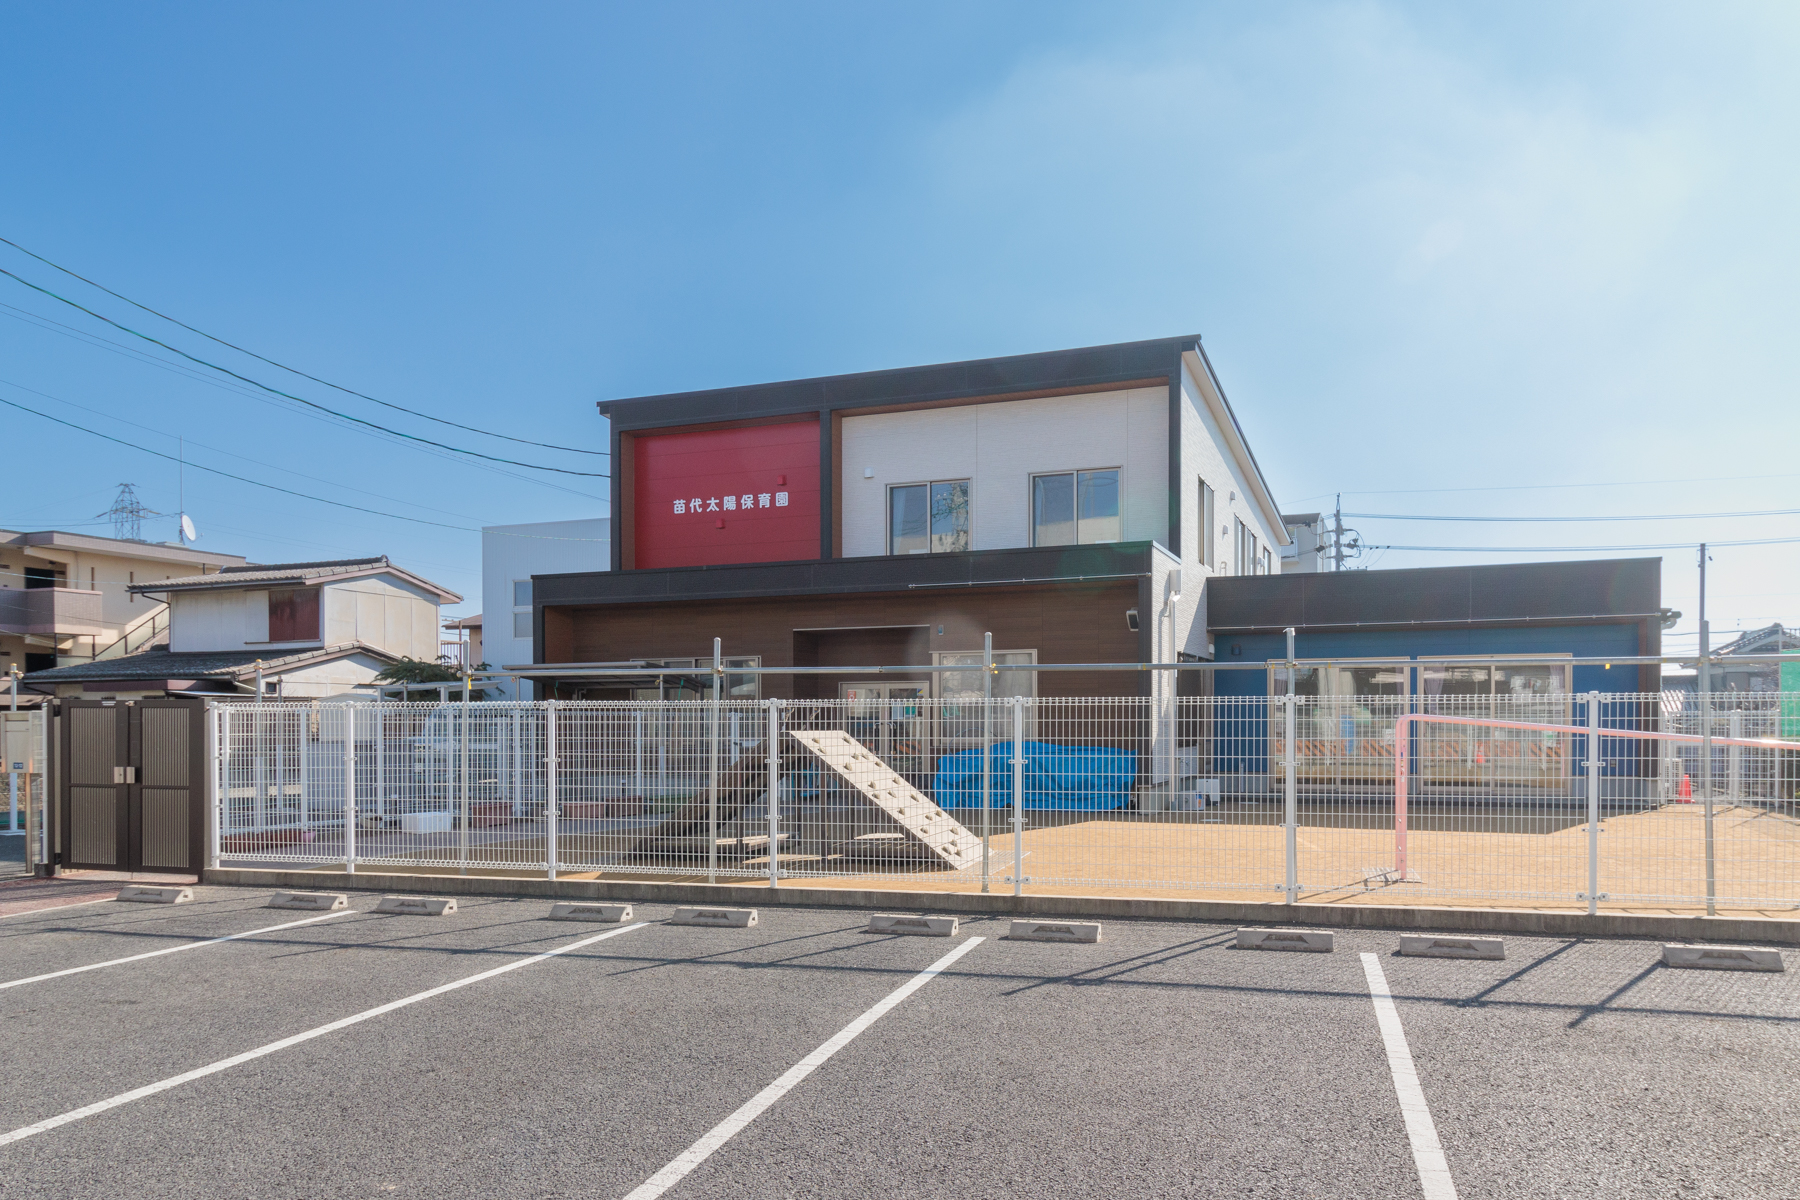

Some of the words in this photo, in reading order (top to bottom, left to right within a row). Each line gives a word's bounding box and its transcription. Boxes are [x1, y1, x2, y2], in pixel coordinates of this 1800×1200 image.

[673, 491, 789, 514] 苗代太陽保育園
